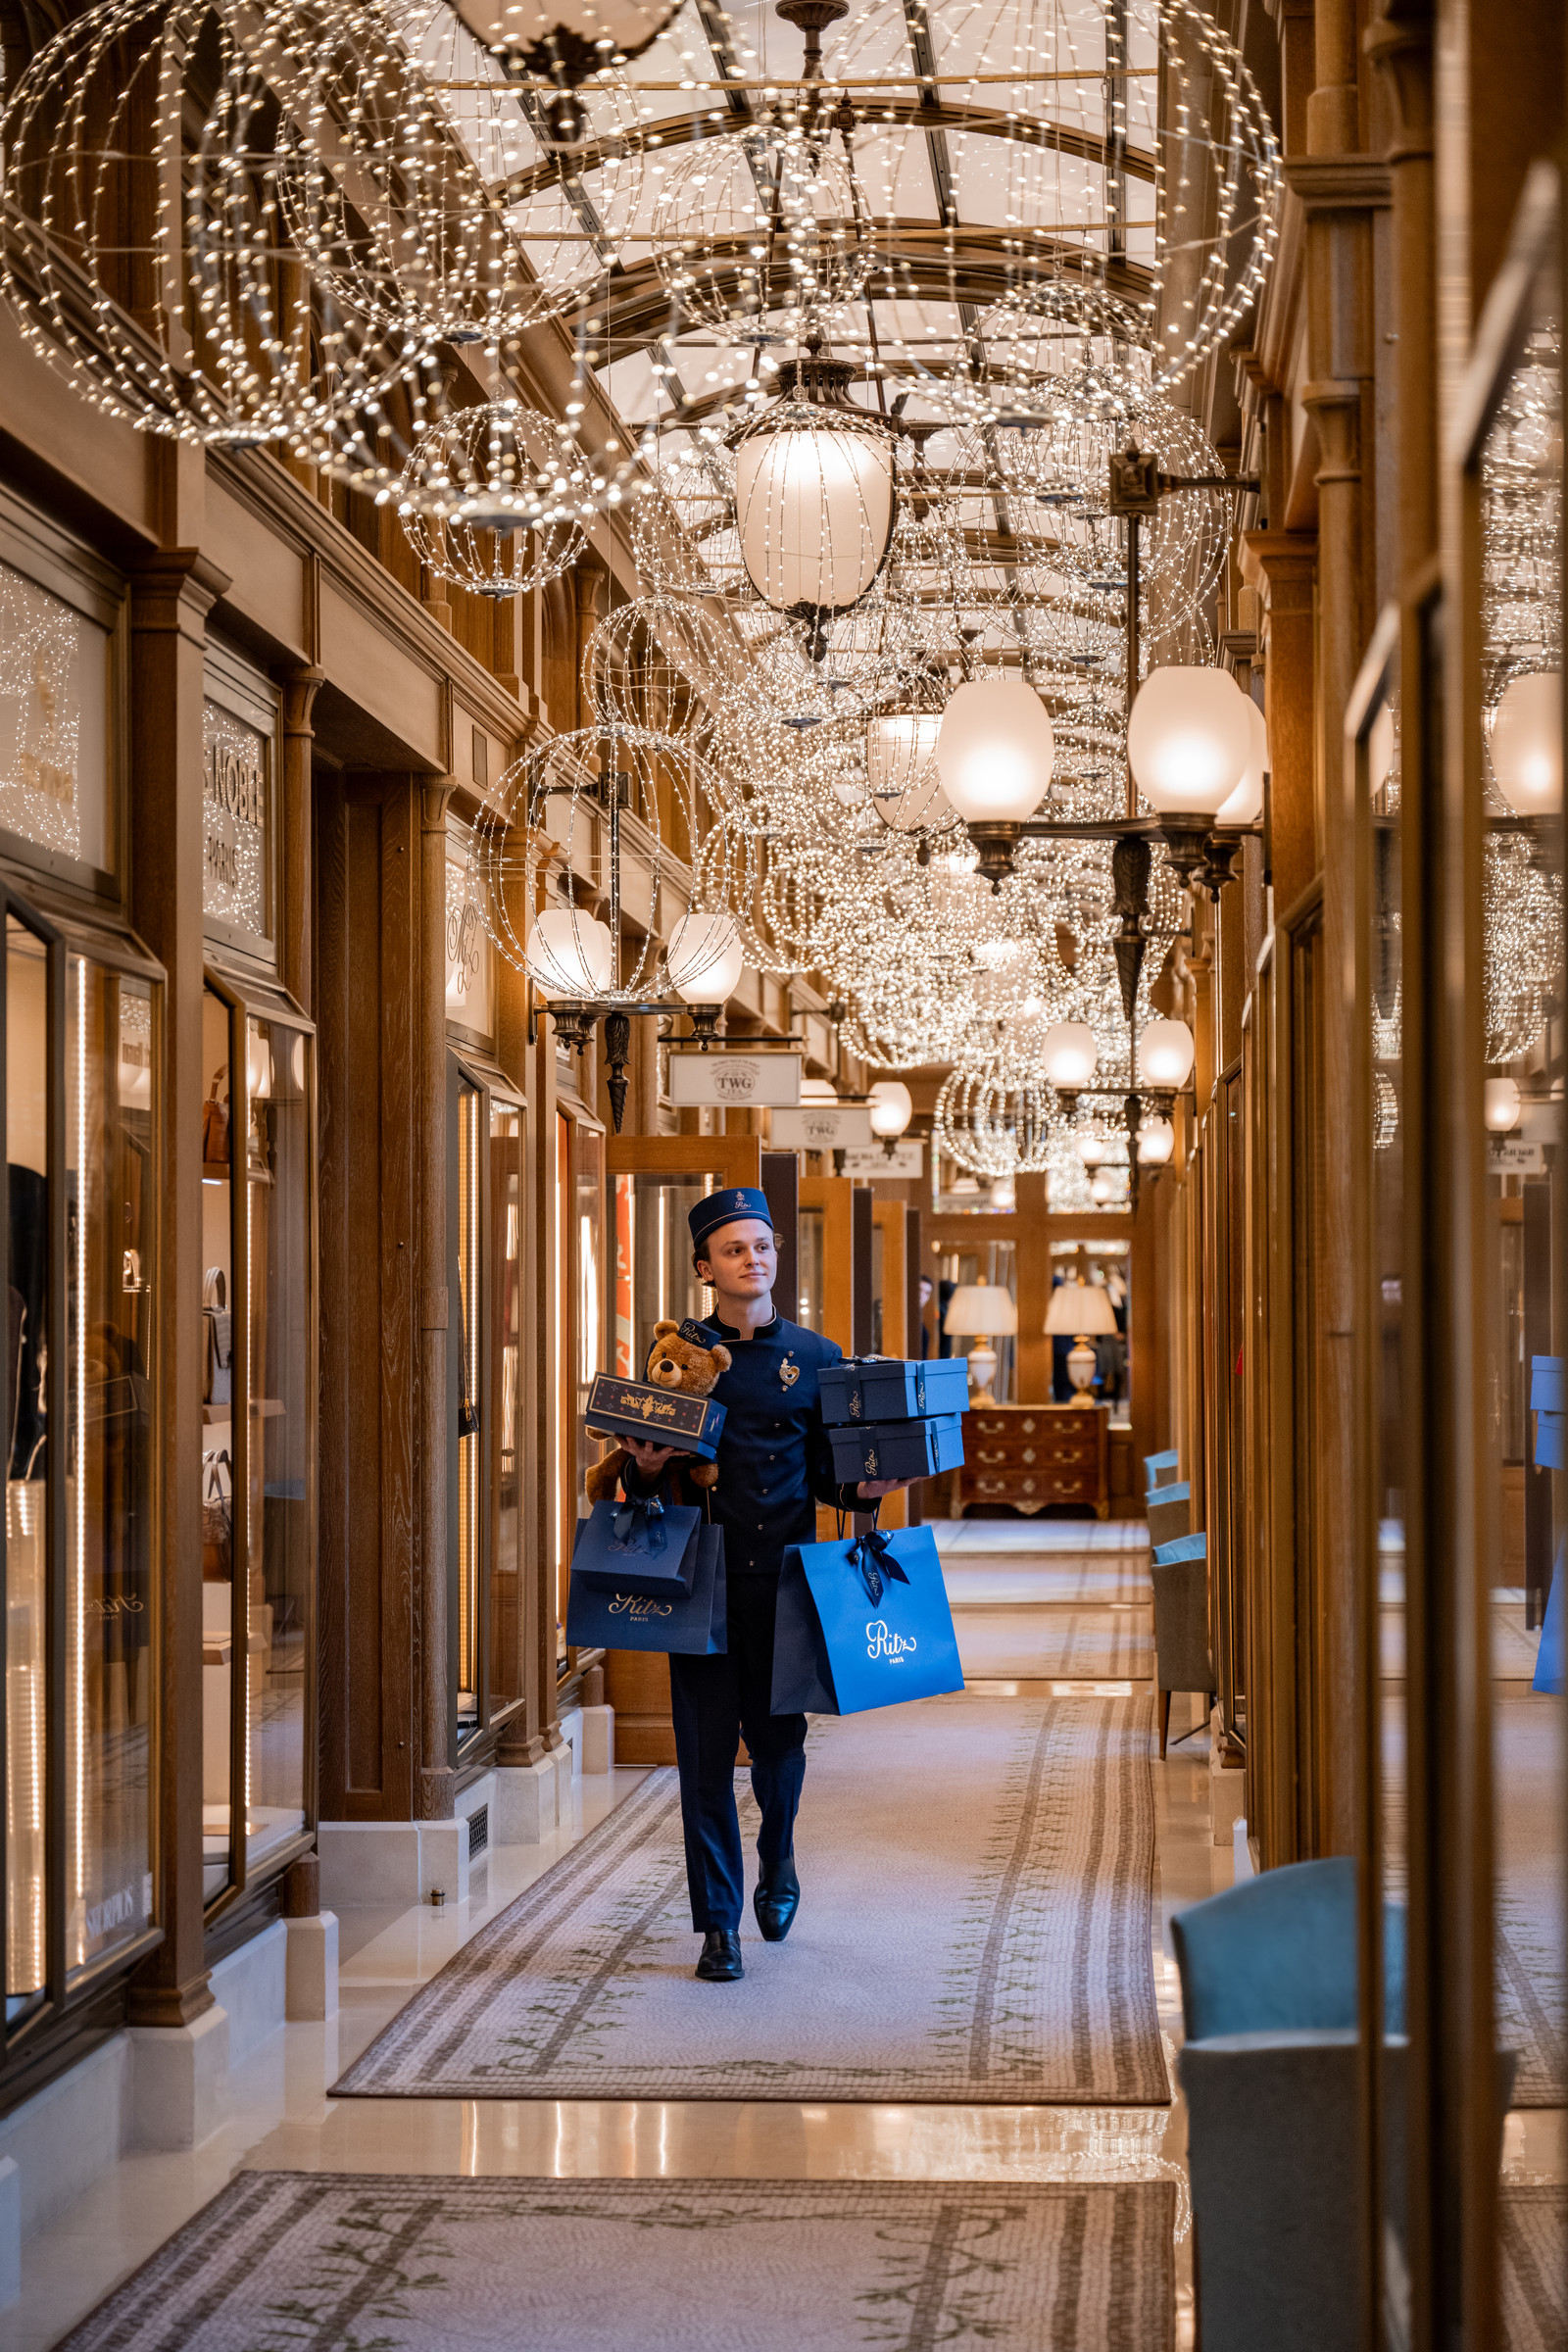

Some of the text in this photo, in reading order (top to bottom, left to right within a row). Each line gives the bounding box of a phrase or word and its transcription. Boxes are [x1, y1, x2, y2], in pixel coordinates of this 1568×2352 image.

[717, 1077, 752, 1090] TWG
[806, 1125, 834, 1135] TWG
[609, 1592, 672, 1616] Ritz
[865, 1620, 917, 1659] Ritz
[889, 1656, 905, 1665] PARIS
